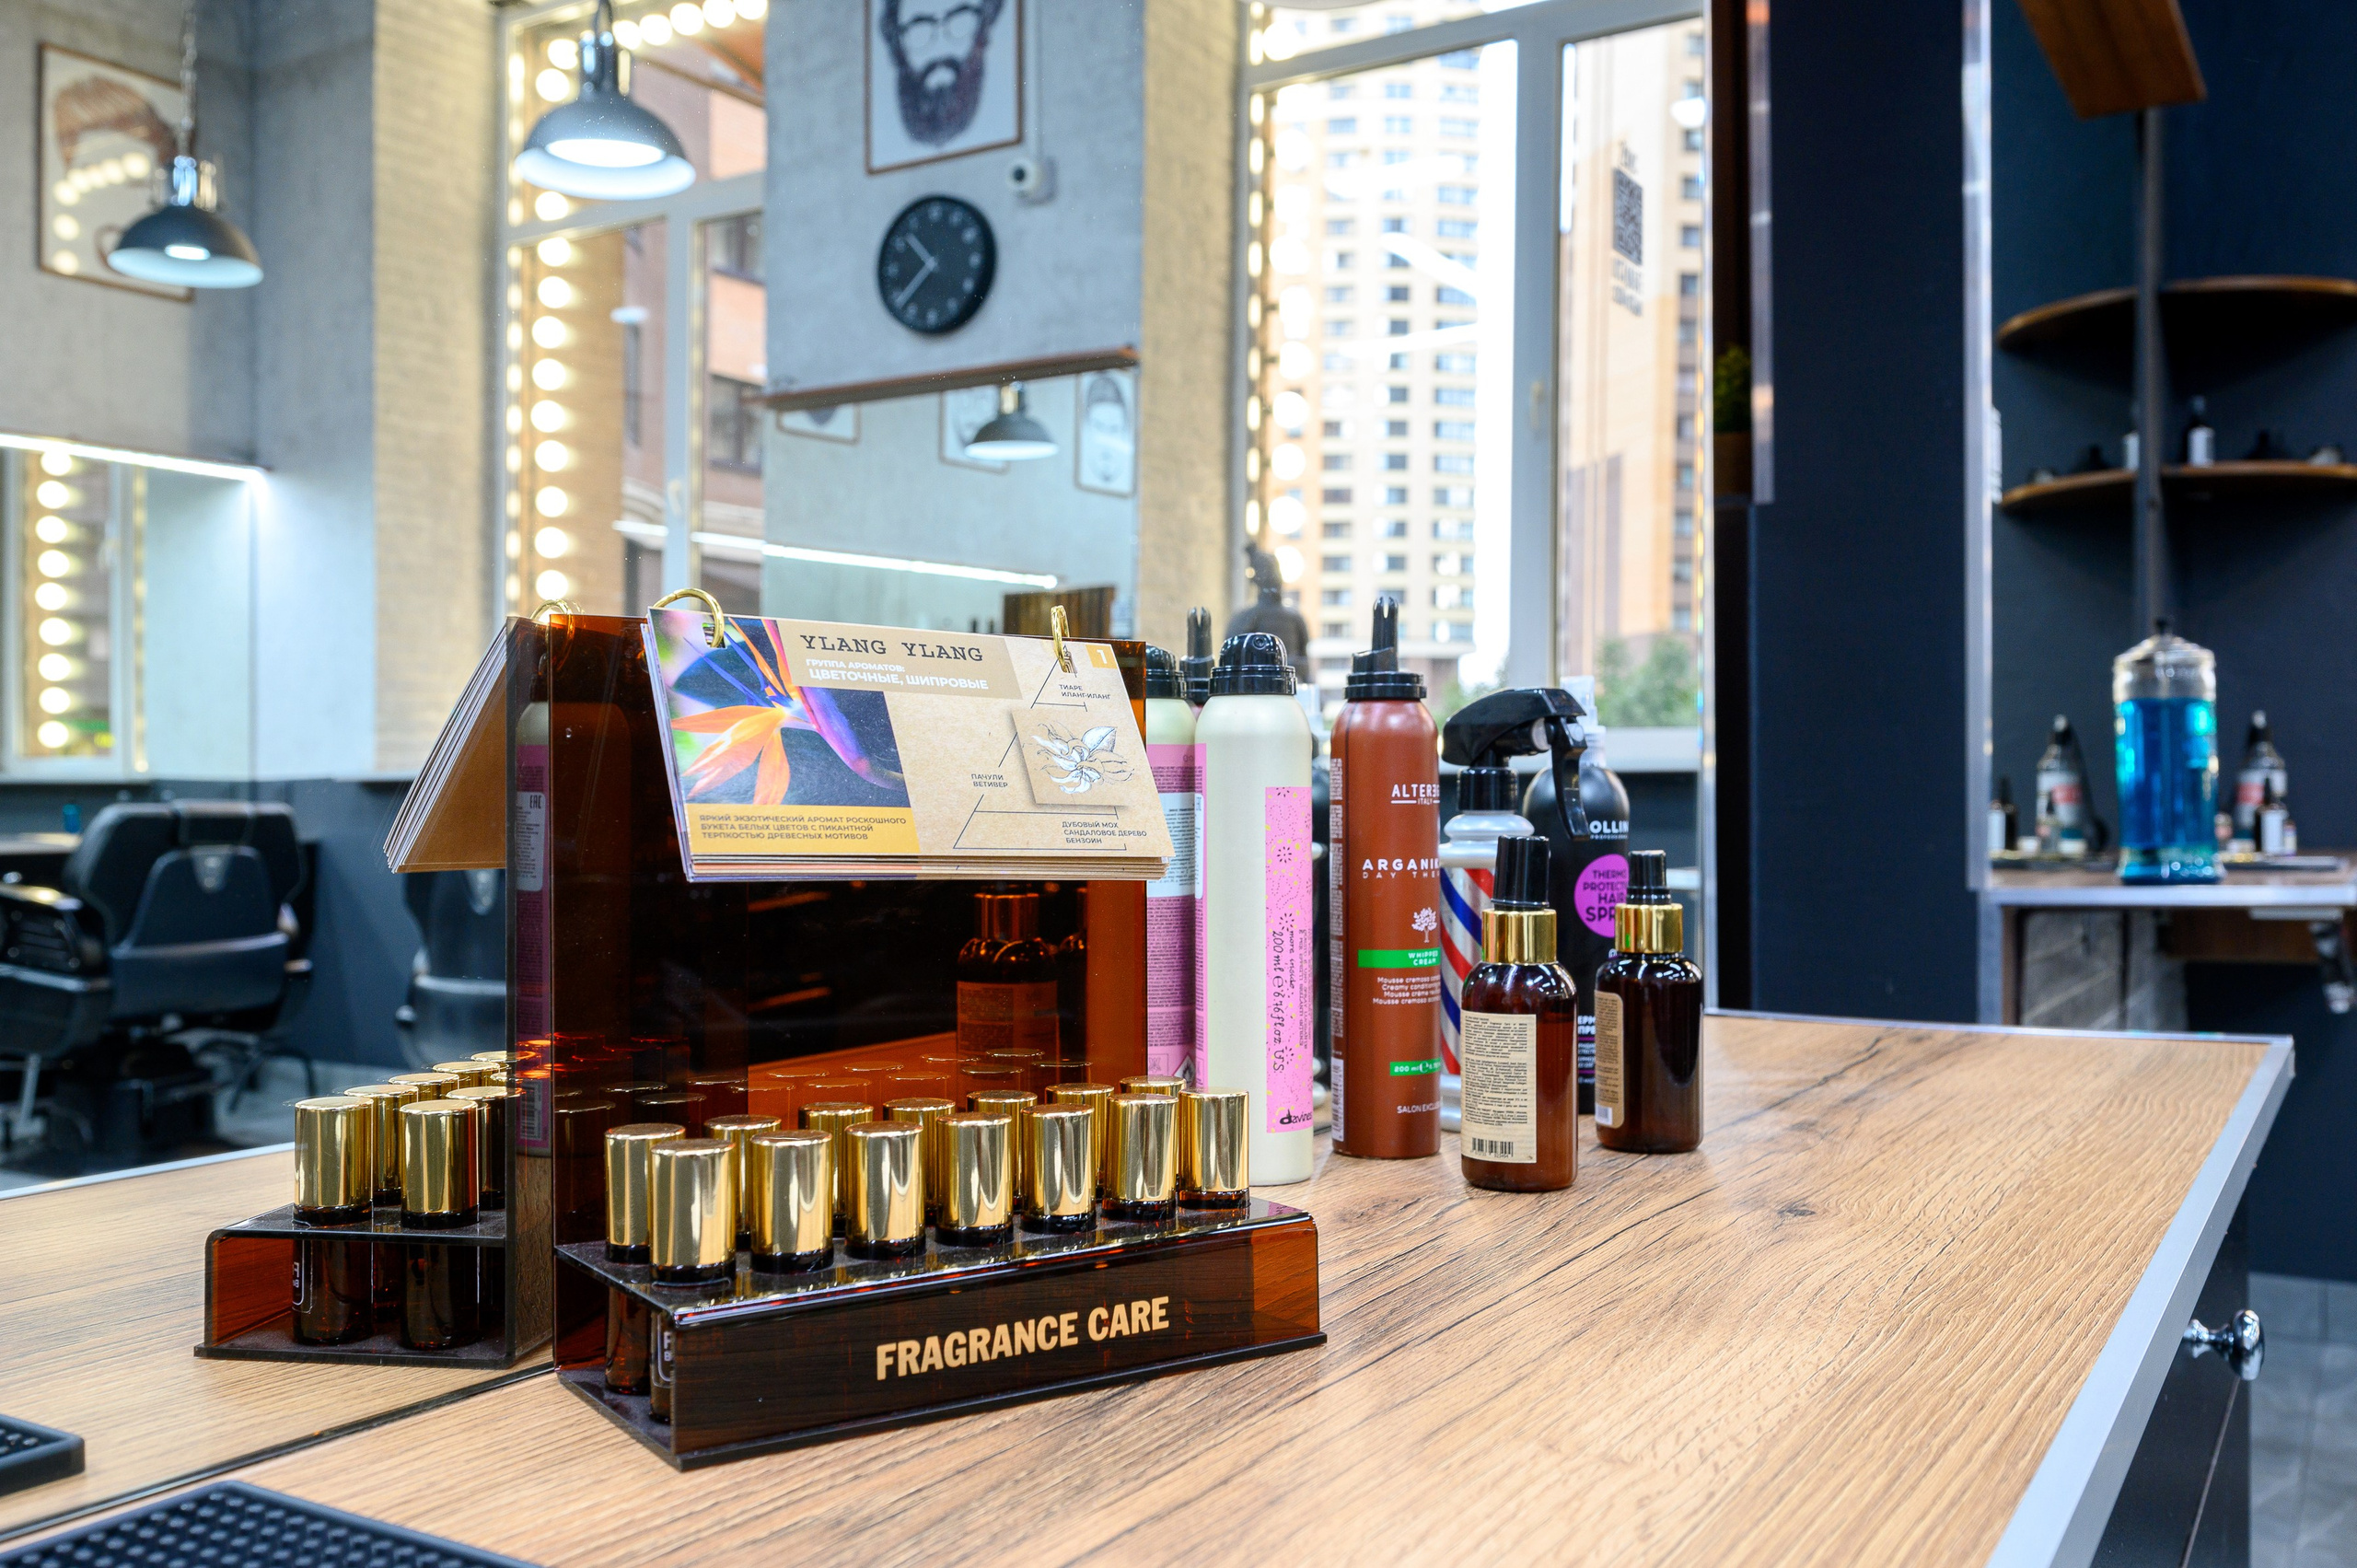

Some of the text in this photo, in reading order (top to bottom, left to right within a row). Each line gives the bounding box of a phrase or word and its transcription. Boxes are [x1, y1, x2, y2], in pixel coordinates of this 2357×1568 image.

[800, 634, 983, 662] YLANG YLANG
[1096, 649, 1108, 665] 1
[806, 658, 906, 673] ГРУППА АРОМАТОВ:
[809, 668, 989, 690] ЦВЕТОЧНЫЕ, ШИПРОВЫЕ
[1062, 691, 1111, 700] ИЛАНГ-ИЛАНГ
[971, 773, 1004, 782] ПАЧУЛИ
[700, 814, 731, 822] ЯРКИЙ
[734, 814, 805, 823] ЭКЗОТИЧЕСКИЙ
[807, 816, 843, 824] АРОМАТ
[773, 824, 808, 832] ЦВЕТОВ
[819, 823, 874, 831] ПИКАНТНОЙ
[1062, 820, 1100, 829] ДУБОВЫЙ
[1363, 871, 1397, 879] DAY
[1598, 892, 1624, 904] HAIR
[1585, 906, 1616, 922] SPR
[1408, 950, 1438, 958] WHIPPED
[1412, 958, 1436, 966] CREAM
[1376, 976, 1404, 984] Mousse
[1397, 1105, 1422, 1114] SALON
[876, 1295, 1169, 1381] FRAGRANCE CARE
